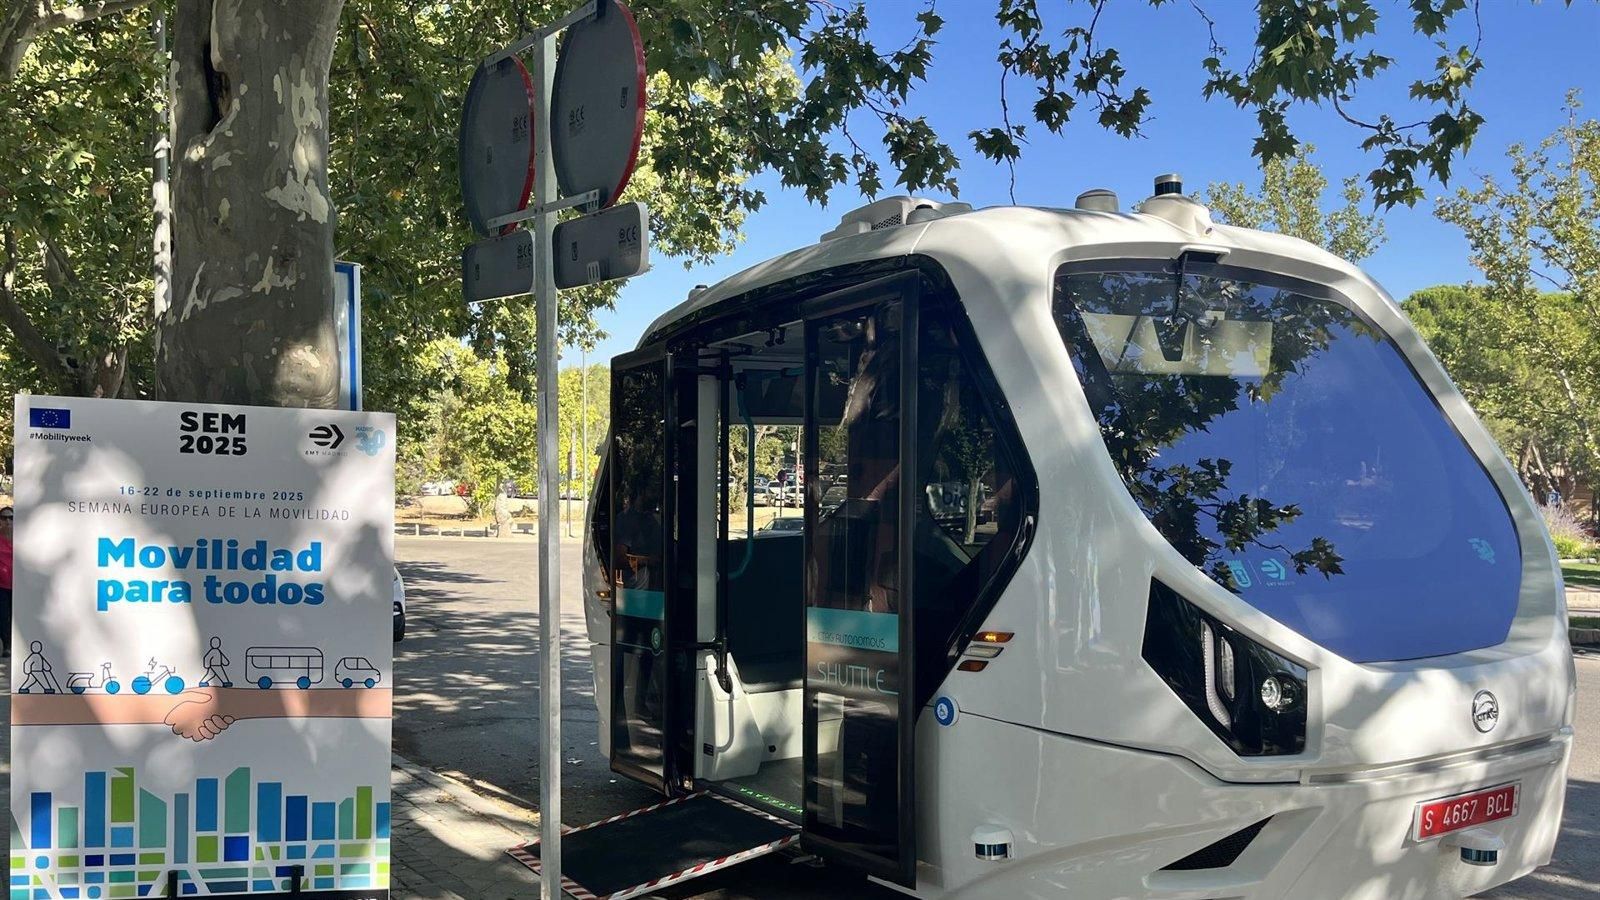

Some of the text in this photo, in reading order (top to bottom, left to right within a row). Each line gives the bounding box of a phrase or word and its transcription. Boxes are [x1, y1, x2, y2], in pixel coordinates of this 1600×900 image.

[180, 411, 247, 434] SEM
[29, 432, 92, 443] #Mobilityweek
[179, 434, 248, 456] 2025
[119, 486, 305, 502] 16-22 de septiembre 2025
[68, 501, 350, 521] SEMANA EUROPEA DE LA MOVILIDAD
[97, 537, 322, 572] Movilidad
[97, 574, 325, 612] para todos
[836, 633, 886, 649] AUTONOMOUS
[817, 661, 899, 695] SHUTTLE
[1424, 792, 1510, 831] S 4667 BCL
